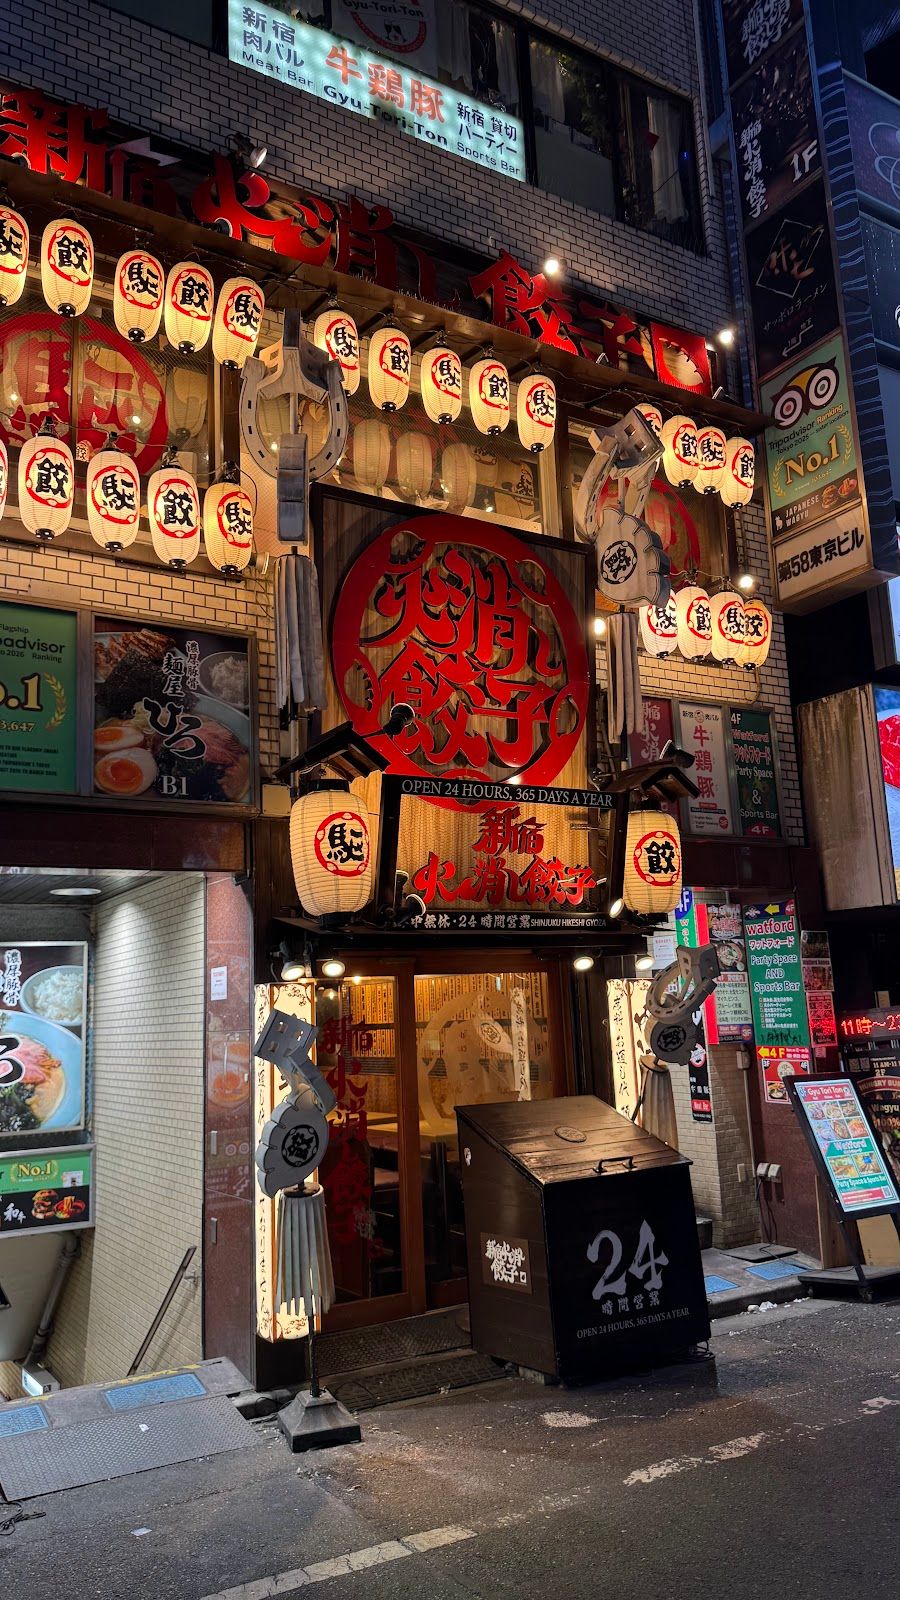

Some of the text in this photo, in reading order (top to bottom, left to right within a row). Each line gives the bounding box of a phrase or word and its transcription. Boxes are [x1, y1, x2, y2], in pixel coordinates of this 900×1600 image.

[243, 6, 295, 46] 新宿
[243, 29, 305, 67] 肉バル
[242, 51, 314, 86] Meat Bar
[325, 46, 445, 124] 牛鶏豚
[324, 85, 448, 145] Gyu-Tori-Ton
[457, 102, 517, 142] 新宿 貸切
[459, 124, 518, 156] パーティー
[457, 141, 520, 175] Sports Bar
[791, 139, 817, 183] 1F
[56, 235, 88, 275] 餃
[179, 276, 210, 314] 餃
[768, 403, 844, 452] Tripadvisor Ranking
[776, 443, 794, 456] Tokyo
[794, 433, 810, 447] 2025
[784, 434, 840, 485] No.1
[36, 458, 69, 498] 餃
[163, 489, 194, 527] 餃
[785, 494, 820, 518] JAPANESE
[786, 509, 809, 528] WAGYU
[777, 527, 865, 584] 第58東京ビル
[32, 653, 62, 664] Ranking
[186, 640, 200, 690] 濃厚豚骨
[730, 713, 741, 724] 4F
[693, 725, 715, 798] 牛鶏豚
[737, 765, 773, 779] Party Space
[161, 775, 189, 796] B1
[402, 779, 613, 807] OPEN 24 HOURS, 365 DAYS A YEAR
[752, 790, 762, 804] &
[740, 809, 778, 819] Sports Bar
[751, 826, 769, 834] 4F
[472, 806, 547, 856] 新宿
[644, 840, 677, 874] 餃
[412, 852, 598, 906] 火消し餃子
[531, 918, 561, 927] SHINJUKU
[561, 918, 586, 928] HIKESHI
[586, 918, 607, 928] GYOZA
[785, 903, 796, 913] 4F
[746, 915, 796, 935] watford
[749, 936, 794, 950] ワットフォード
[751, 953, 797, 967] Party Space
[765, 968, 785, 979] AND
[4, 951, 22, 1007] 濃厚豚骨
[754, 981, 783, 994] Sports
[784, 980, 800, 991] Bar
[808, 1086, 844, 1096] Gyu Tori Ton
[871, 1104, 899, 1114] Wagyu
[18, 1161, 52, 1177] No.1
[849, 1178, 863, 1187] Space
[586, 1219, 670, 1301] 24
[602, 1290, 660, 1316] 時間営業
[577, 1307, 690, 1339] OPEN 24 HOURS, 365 DAYS A YEAR
